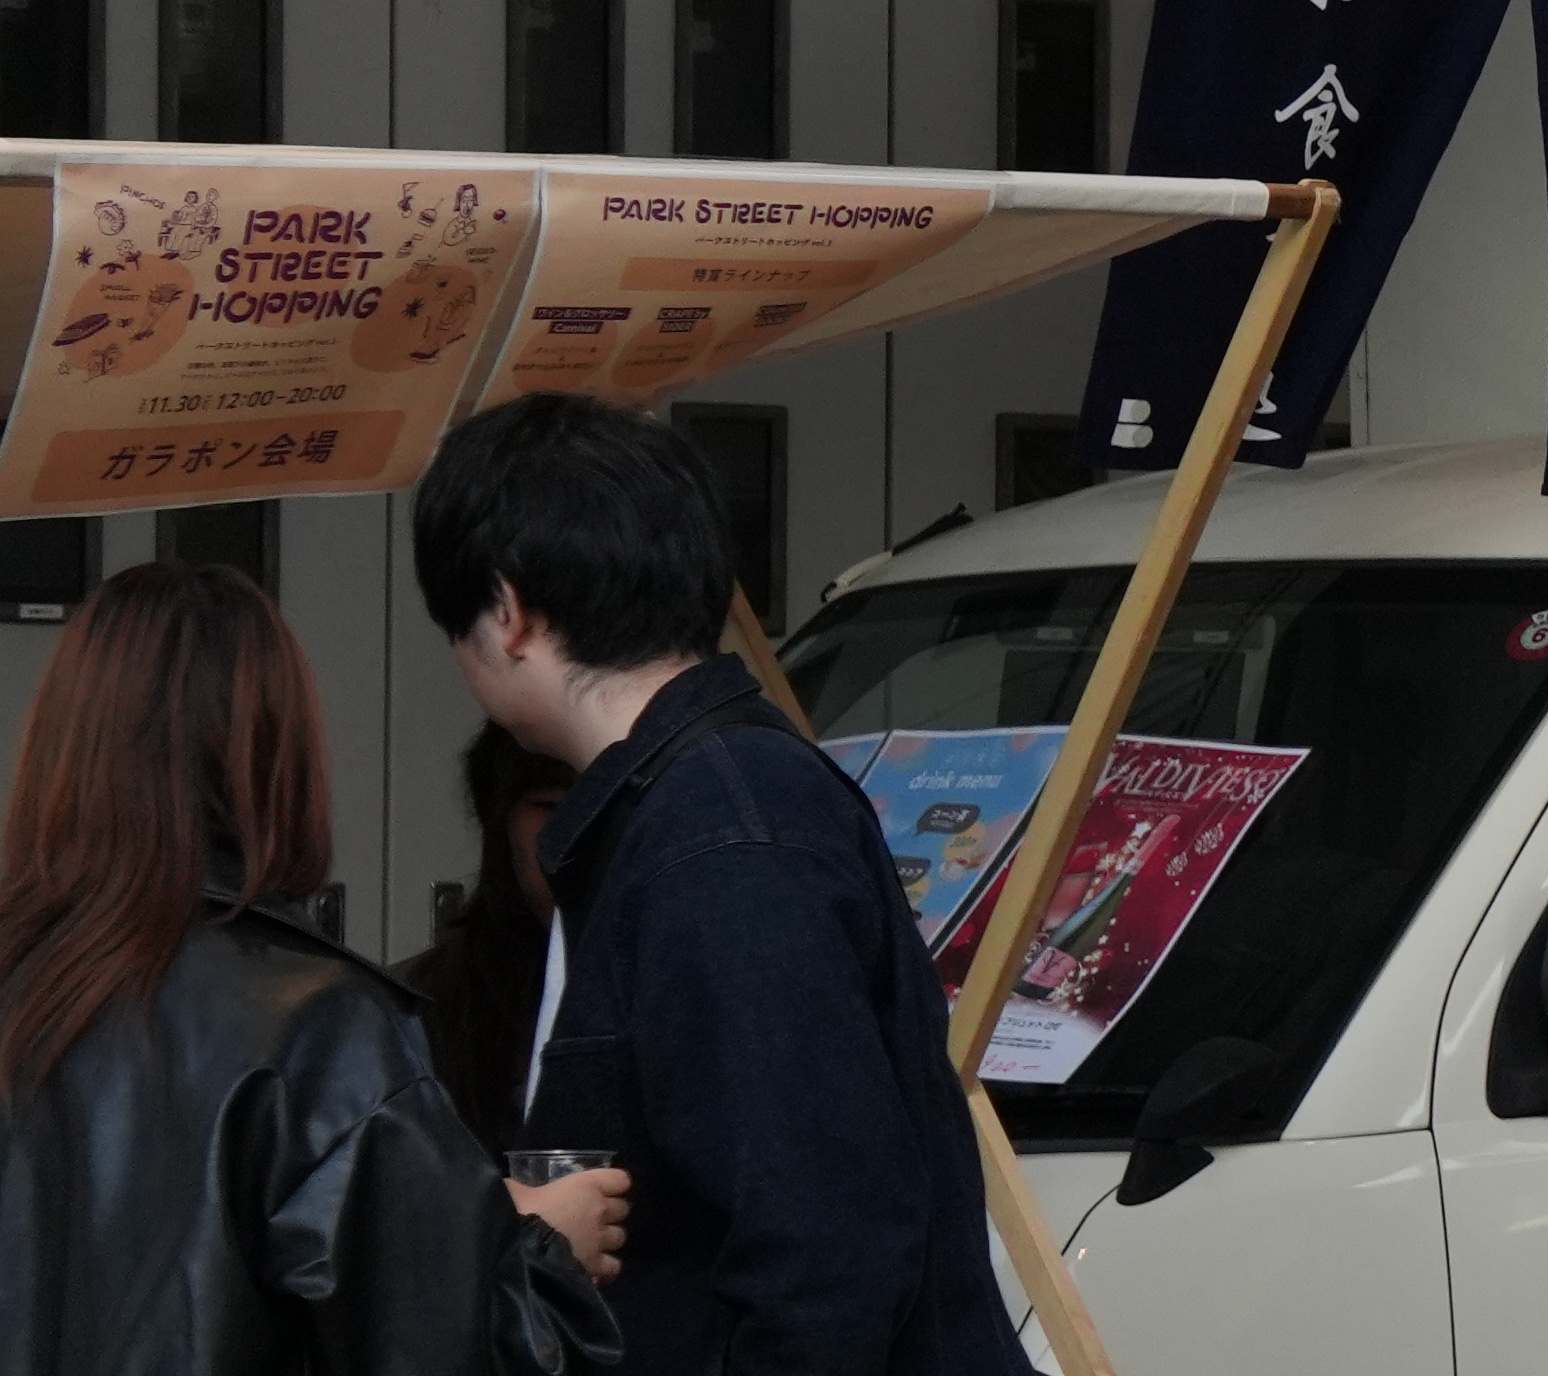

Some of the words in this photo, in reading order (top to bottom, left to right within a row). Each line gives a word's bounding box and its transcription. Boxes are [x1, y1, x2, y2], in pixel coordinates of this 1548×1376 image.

[243, 209, 372, 245] PARK
[603, 195, 685, 222] PARK
[695, 198, 805, 225] STREET
[810, 205, 934, 230] HOPPING
[215, 248, 384, 284] STREET
[187, 286, 384, 325] HOPPING
[101, 430, 340, 481] ガラポン会場
[1532, 627, 1548, 643] 6
[908, 770, 957, 791] drink
[957, 772, 1005, 790] menu
[1092, 752, 1288, 804] VALDIVIESO
